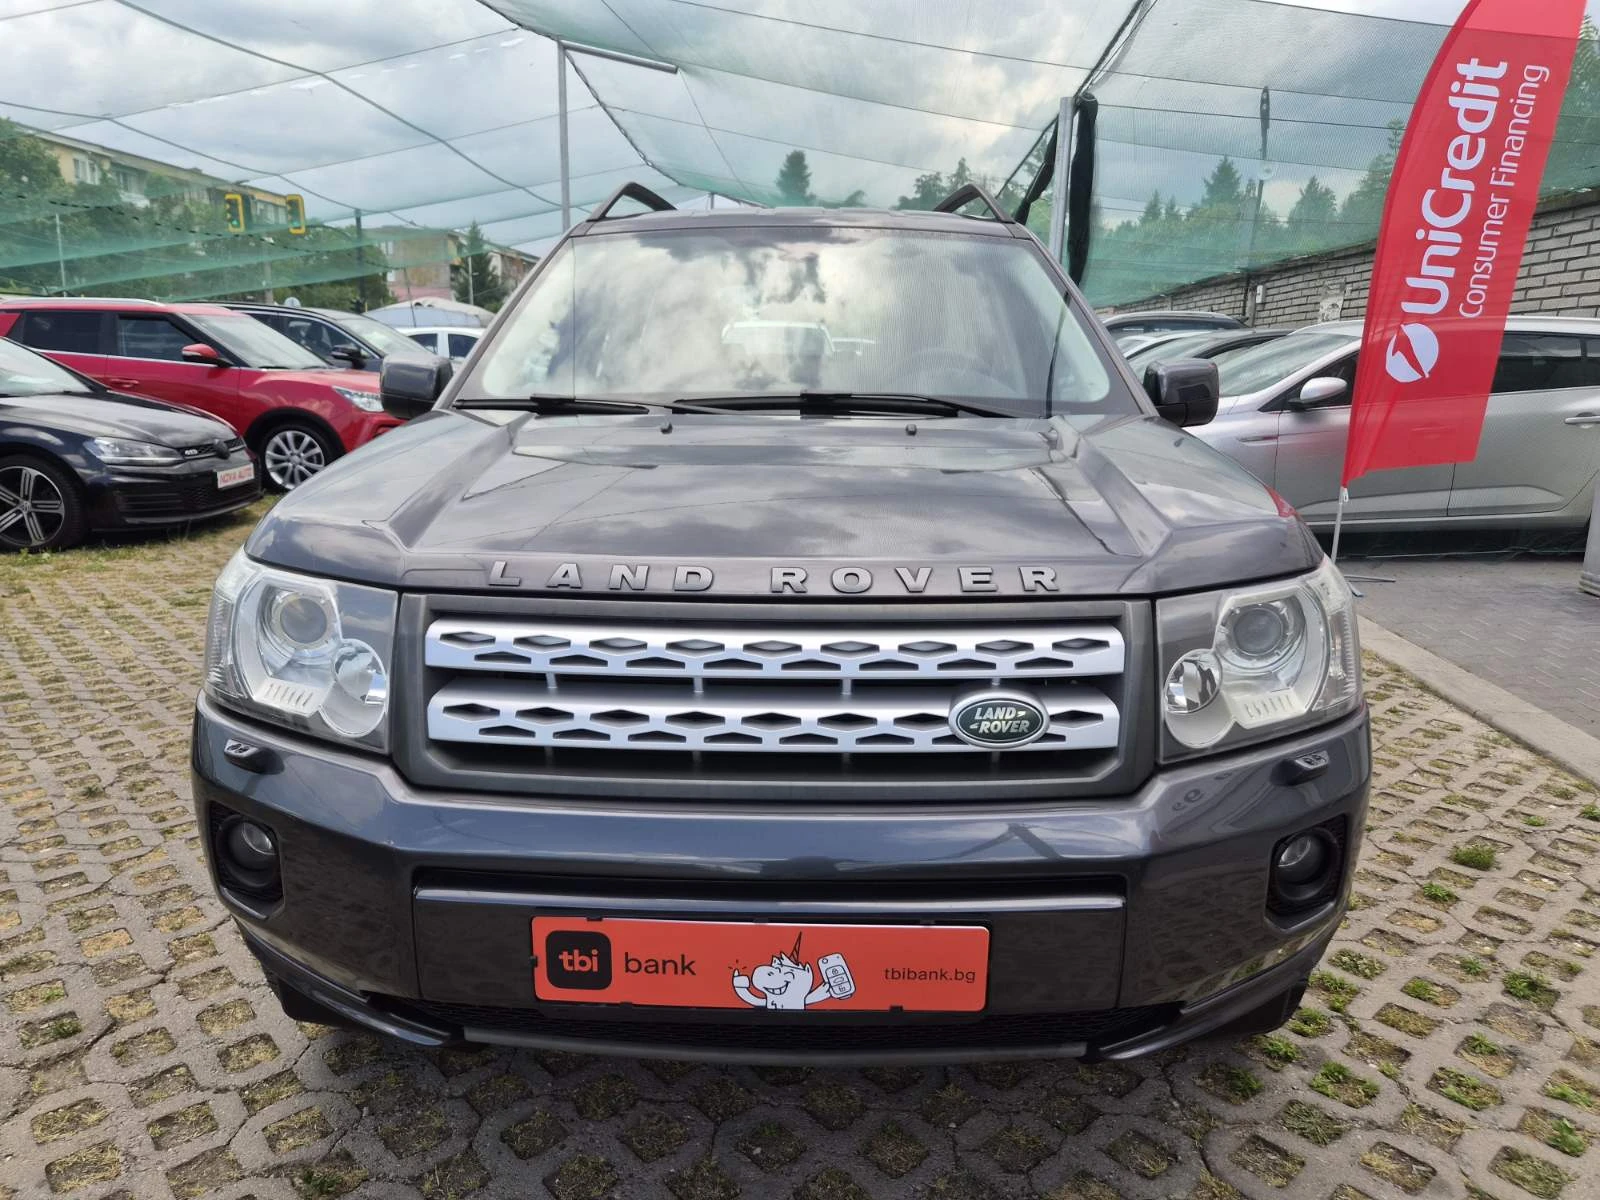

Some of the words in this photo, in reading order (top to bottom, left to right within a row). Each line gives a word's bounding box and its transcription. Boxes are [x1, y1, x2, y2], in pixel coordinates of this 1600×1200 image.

[1400, 57, 1509, 315] UniCredit
[1458, 194, 1510, 319] Consumer
[1489, 64, 1551, 187] Financing
[487, 560, 714, 592] LAND
[769, 565, 1060, 594] ROVER
[974, 706, 1017, 720] LAND
[978, 720, 1031, 733] ROVER
[558, 949, 600, 973] tbi
[624, 952, 697, 976] bank
[884, 967, 977, 984] tbibank.bg
